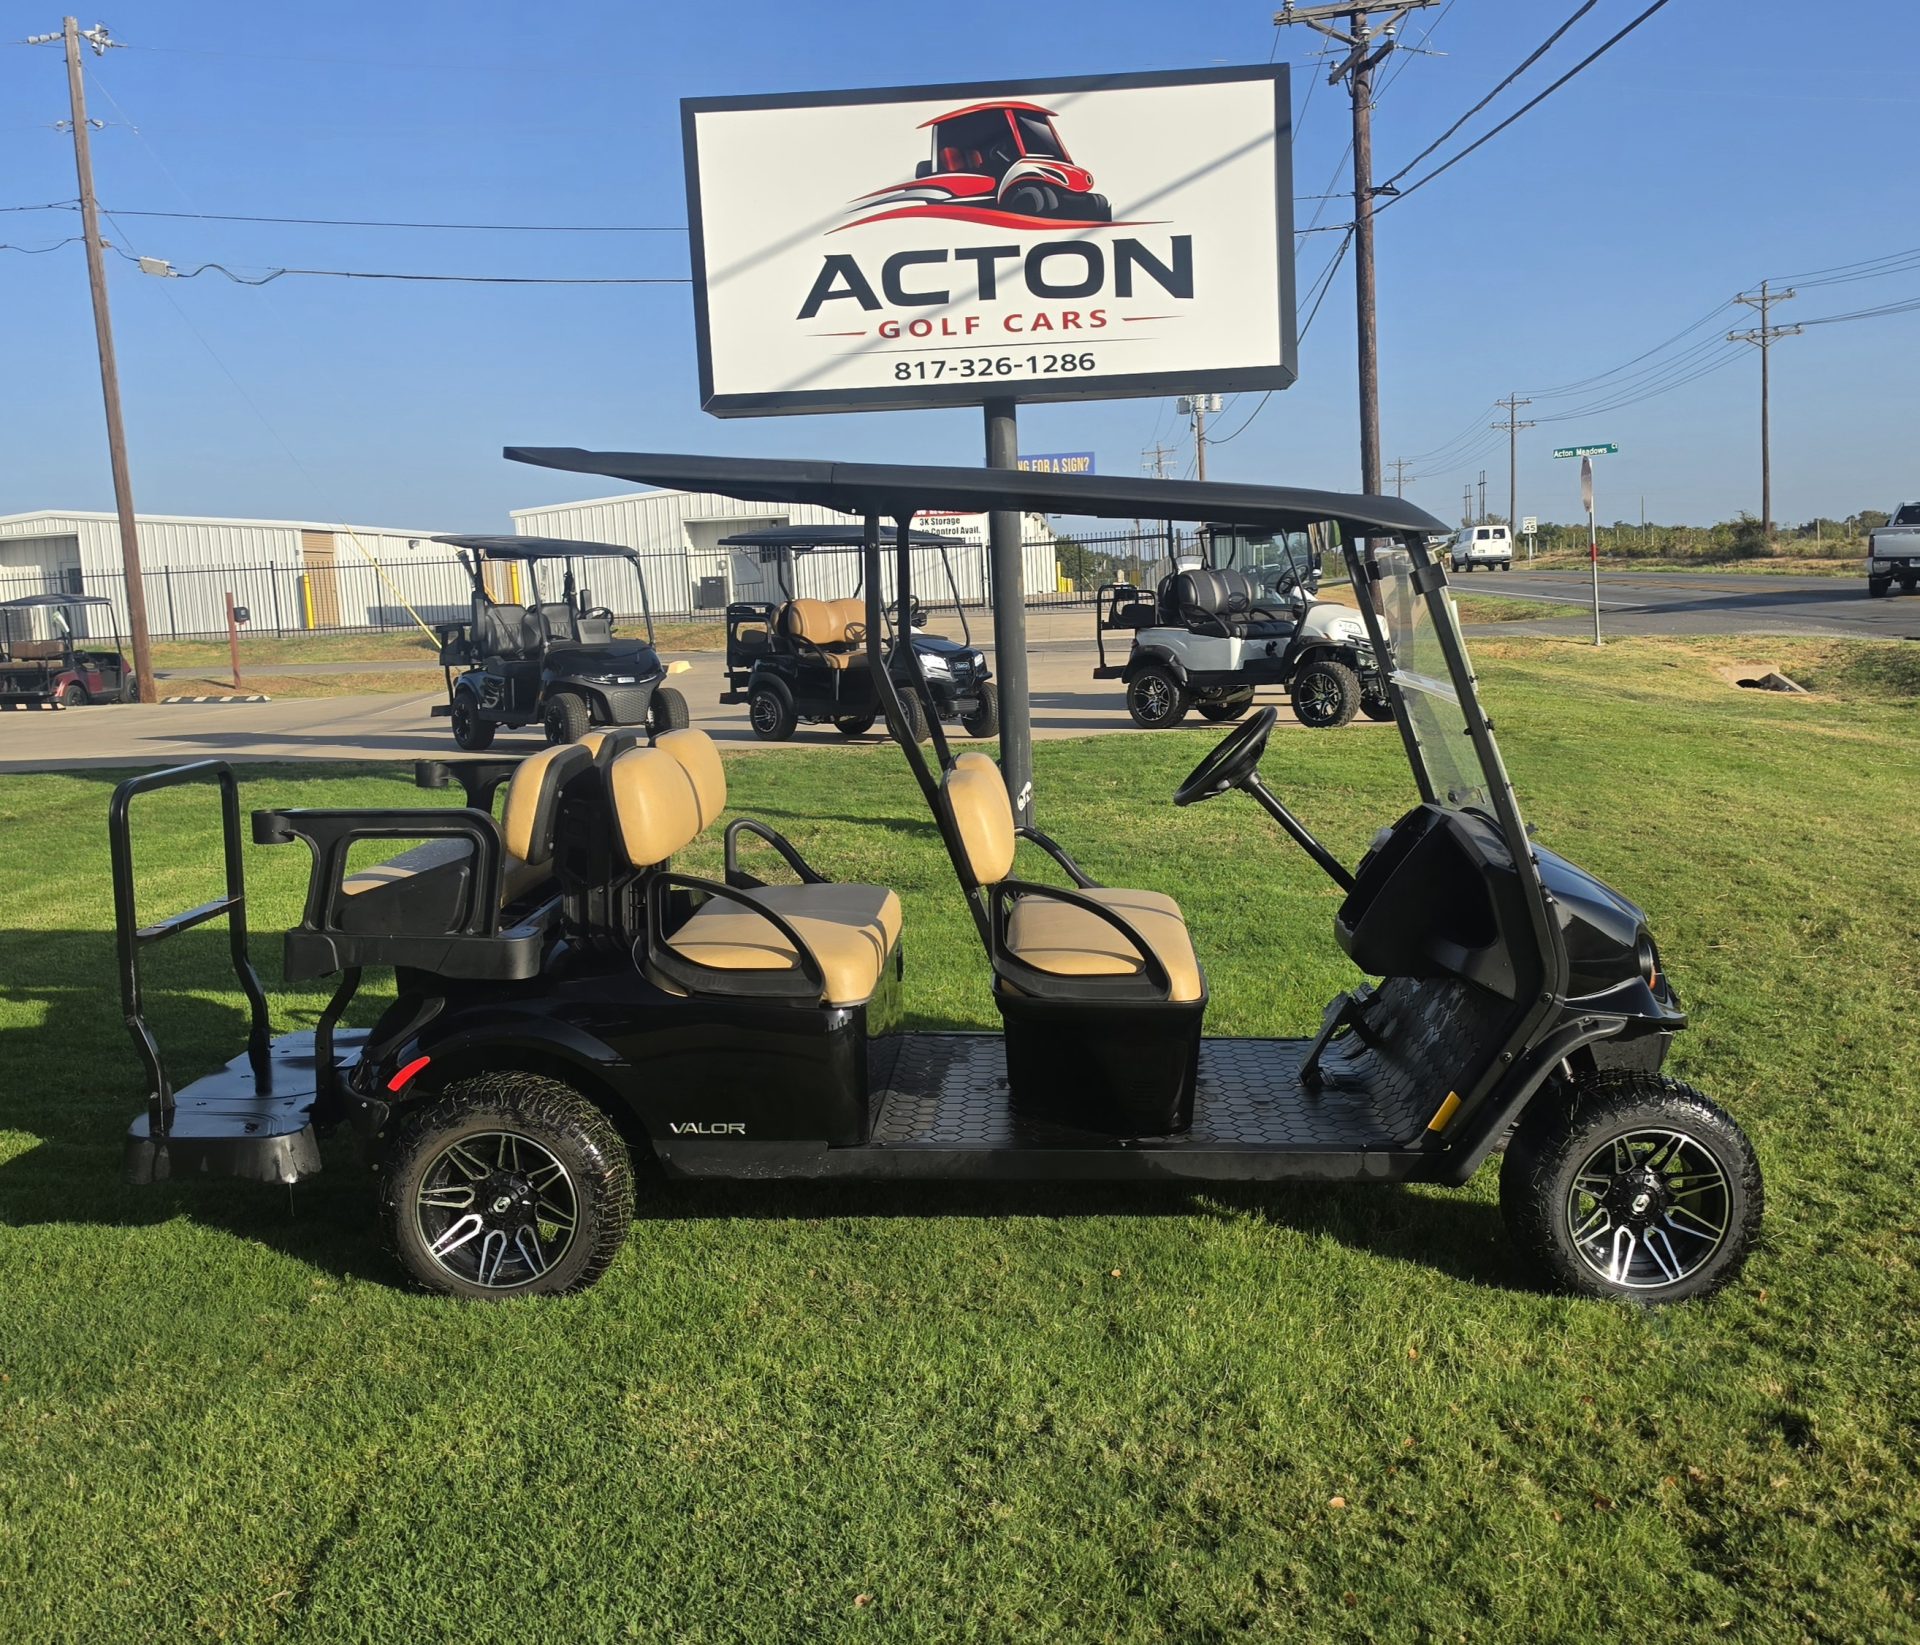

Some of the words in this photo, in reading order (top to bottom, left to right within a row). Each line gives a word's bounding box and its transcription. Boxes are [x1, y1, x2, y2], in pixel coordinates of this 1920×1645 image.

[797, 235, 1194, 320] ACTON
[879, 316, 980, 338] GOLF
[1003, 310, 1107, 332] CARS
[895, 353, 1095, 380] 817-326-1286
[1554, 450, 1573, 458] Acton
[1576, 447, 1607, 457] Meadows
[1032, 459, 1050, 473] FOR
[1053, 458, 1060, 473] A
[1062, 457, 1089, 472] SIGN?
[931, 517, 960, 526] Storage
[931, 527, 959, 535] Control
[961, 526, 981, 534] Avail.
[669, 1122, 746, 1135] VALOR
